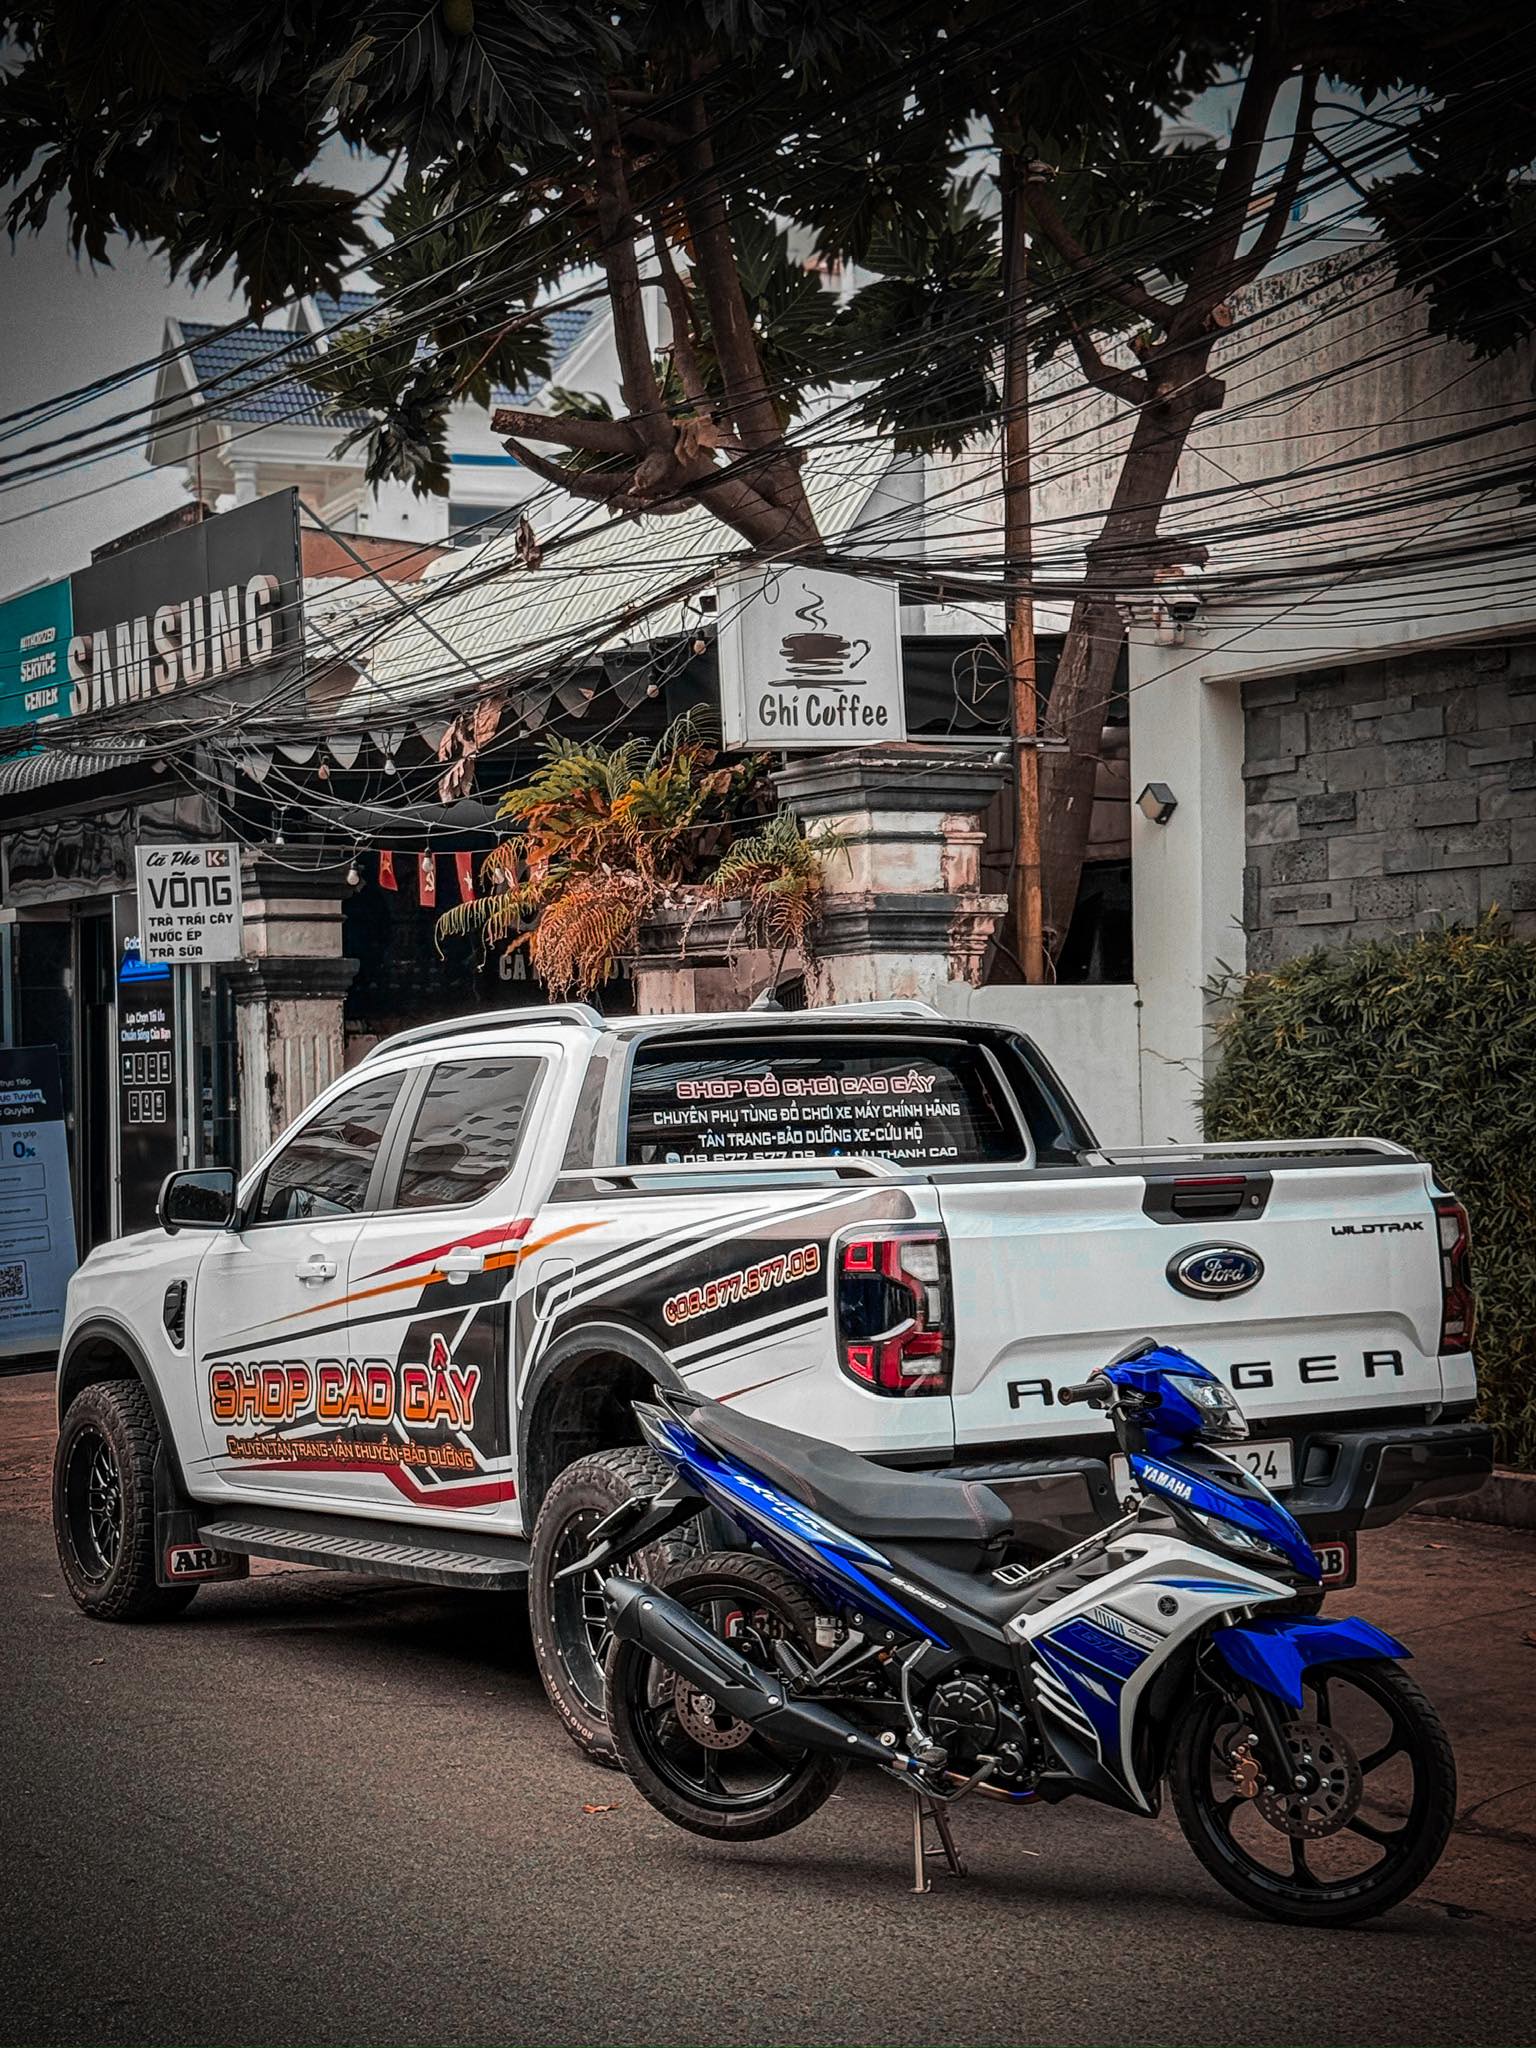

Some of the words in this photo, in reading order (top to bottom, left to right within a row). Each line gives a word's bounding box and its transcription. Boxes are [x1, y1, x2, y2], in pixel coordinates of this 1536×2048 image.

[67, 574, 276, 717] SAMSUNG
[20, 651, 56, 682] SERVICE
[25, 687, 58, 712] CENTER
[759, 694, 799, 726] Ghi
[806, 694, 888, 726] Coffee
[147, 872, 232, 909] VÕNG
[149, 913, 174, 927] TRÀ
[177, 912, 206, 926] TRÁI
[209, 912, 234, 925] CÂY
[149, 929, 183, 943] NƯỚC
[187, 928, 202, 941] ÉP
[149, 944, 175, 957] TRÀ
[677, 1080, 742, 1099] SHOP
[745, 1072, 780, 1097] ĐỒ
[782, 1075, 838, 1096] CHƠI
[840, 1077, 889, 1095] CAO
[653, 1105, 708, 1125] CHUYÊN
[711, 1110, 739, 1127] PHỤ
[741, 1104, 777, 1123] TÙNG
[780, 1100, 800, 1121] ĐỒ
[802, 1104, 834, 1121] CHƠI
[836, 1106, 852, 1120] XE
[855, 1100, 881, 1119] MÁY
[882, 1099, 923, 1118] CHÍNH
[698, 1128, 726, 1148] TÂN
[806, 1124, 851, 1144] DƯỠNG
[905, 1121, 923, 1144] HỘ
[13, 1141, 36, 1158] 0%
[878, 1148, 926, 1159] THANH
[929, 1147, 958, 1158] CAO
[1331, 1221, 1424, 1236] WILDTRAK
[1201, 1257, 1245, 1283] Ford
[210, 1360, 313, 1426] SHOP
[316, 1359, 397, 1426] CAO
[401, 1333, 480, 1431] GẦY
[1007, 1350, 1405, 1409] RGER
[1141, 1464, 1192, 1500] YAMAHA
